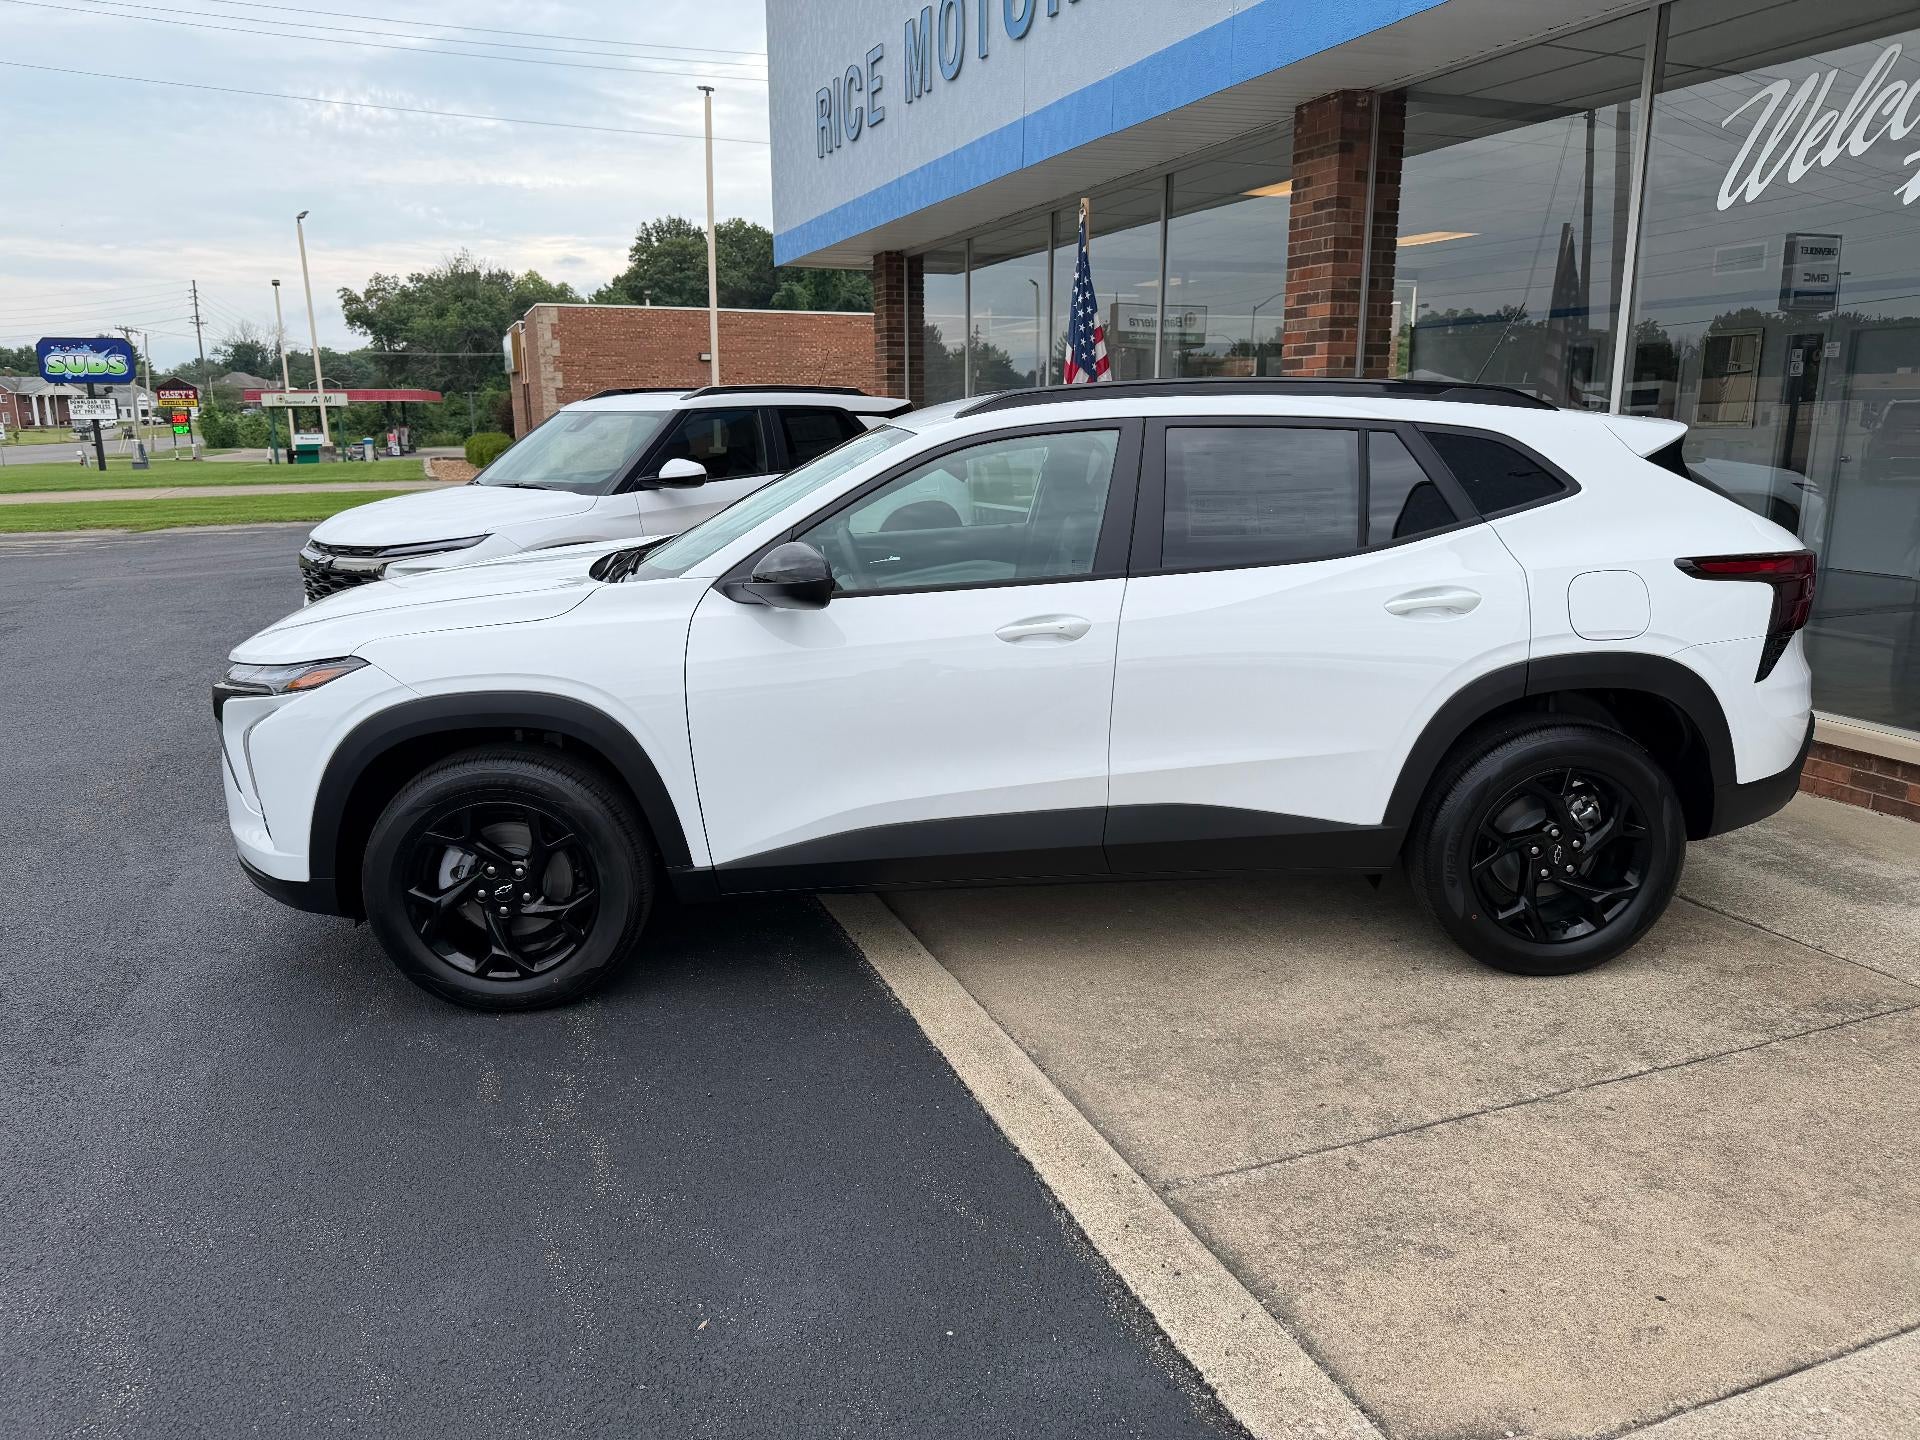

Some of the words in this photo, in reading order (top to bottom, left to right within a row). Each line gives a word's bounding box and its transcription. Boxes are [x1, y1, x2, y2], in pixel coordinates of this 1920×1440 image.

[815, 42, 885, 158] RICE
[904, 0, 1081, 104] MOT
[45, 354, 128, 376] SUDS
[160, 390, 195, 399] CASEY'S
[311, 395, 332, 403] AM
